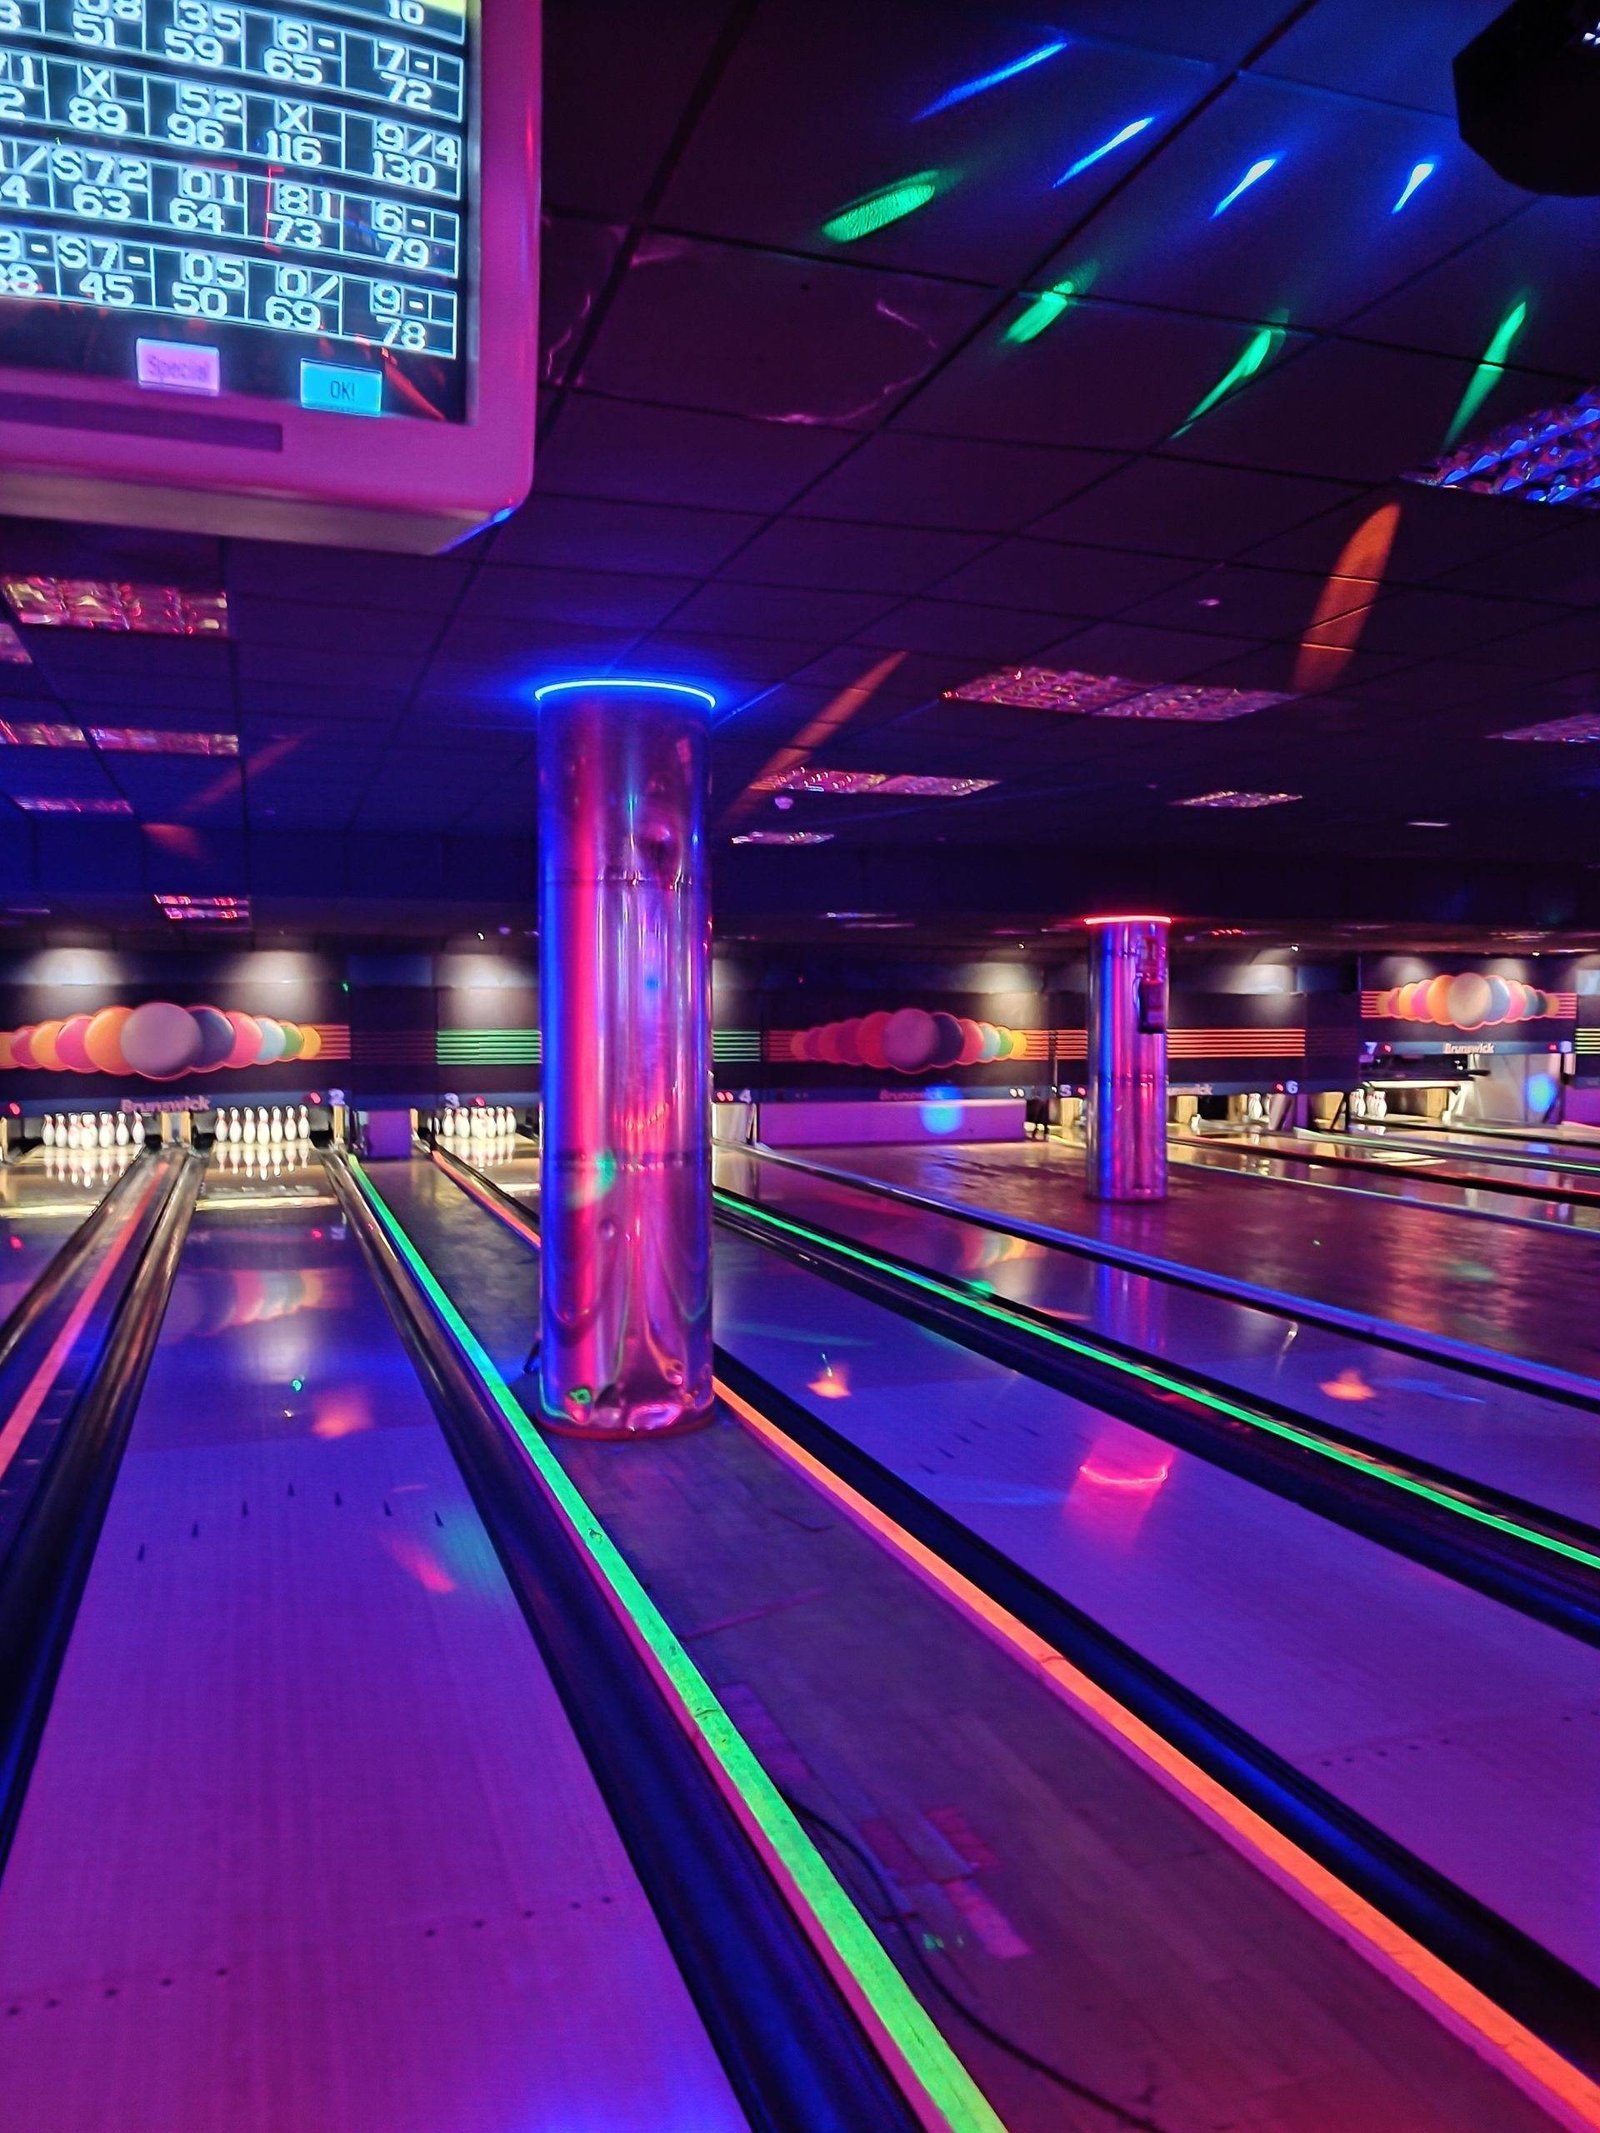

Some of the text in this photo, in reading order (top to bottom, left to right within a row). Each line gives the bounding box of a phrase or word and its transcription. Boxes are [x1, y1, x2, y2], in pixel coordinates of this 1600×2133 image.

[178, 0, 241, 39] 35
[73, 11, 116, 48] 51
[164, 28, 223, 66] 59
[264, 49, 322, 85] 65
[380, 71, 432, 111] 72
[82, 66, 112, 100] X
[181, 87, 242, 123] 52
[278, 102, 309, 133] X
[69, 97, 127, 134] 89
[167, 113, 225, 150] 96
[266, 130, 322, 167] 116
[372, 151, 436, 191] 130
[182, 168, 235, 204] 01
[278, 184, 332, 221] 81
[73, 184, 131, 220] 63
[170, 198, 224, 233] 64
[266, 212, 322, 248] 73
[377, 233, 429, 268] 79
[185, 253, 245, 288] 05
[80, 272, 135, 305] 45
[172, 282, 228, 317] 50
[265, 296, 321, 332] 69
[376, 315, 426, 350] 78
[330, 381, 355, 401] OK!
[1442, 1042, 1495, 1054] Brunswick
[738, 1088, 752, 1103] 4
[1286, 1080, 1299, 1094] 6
